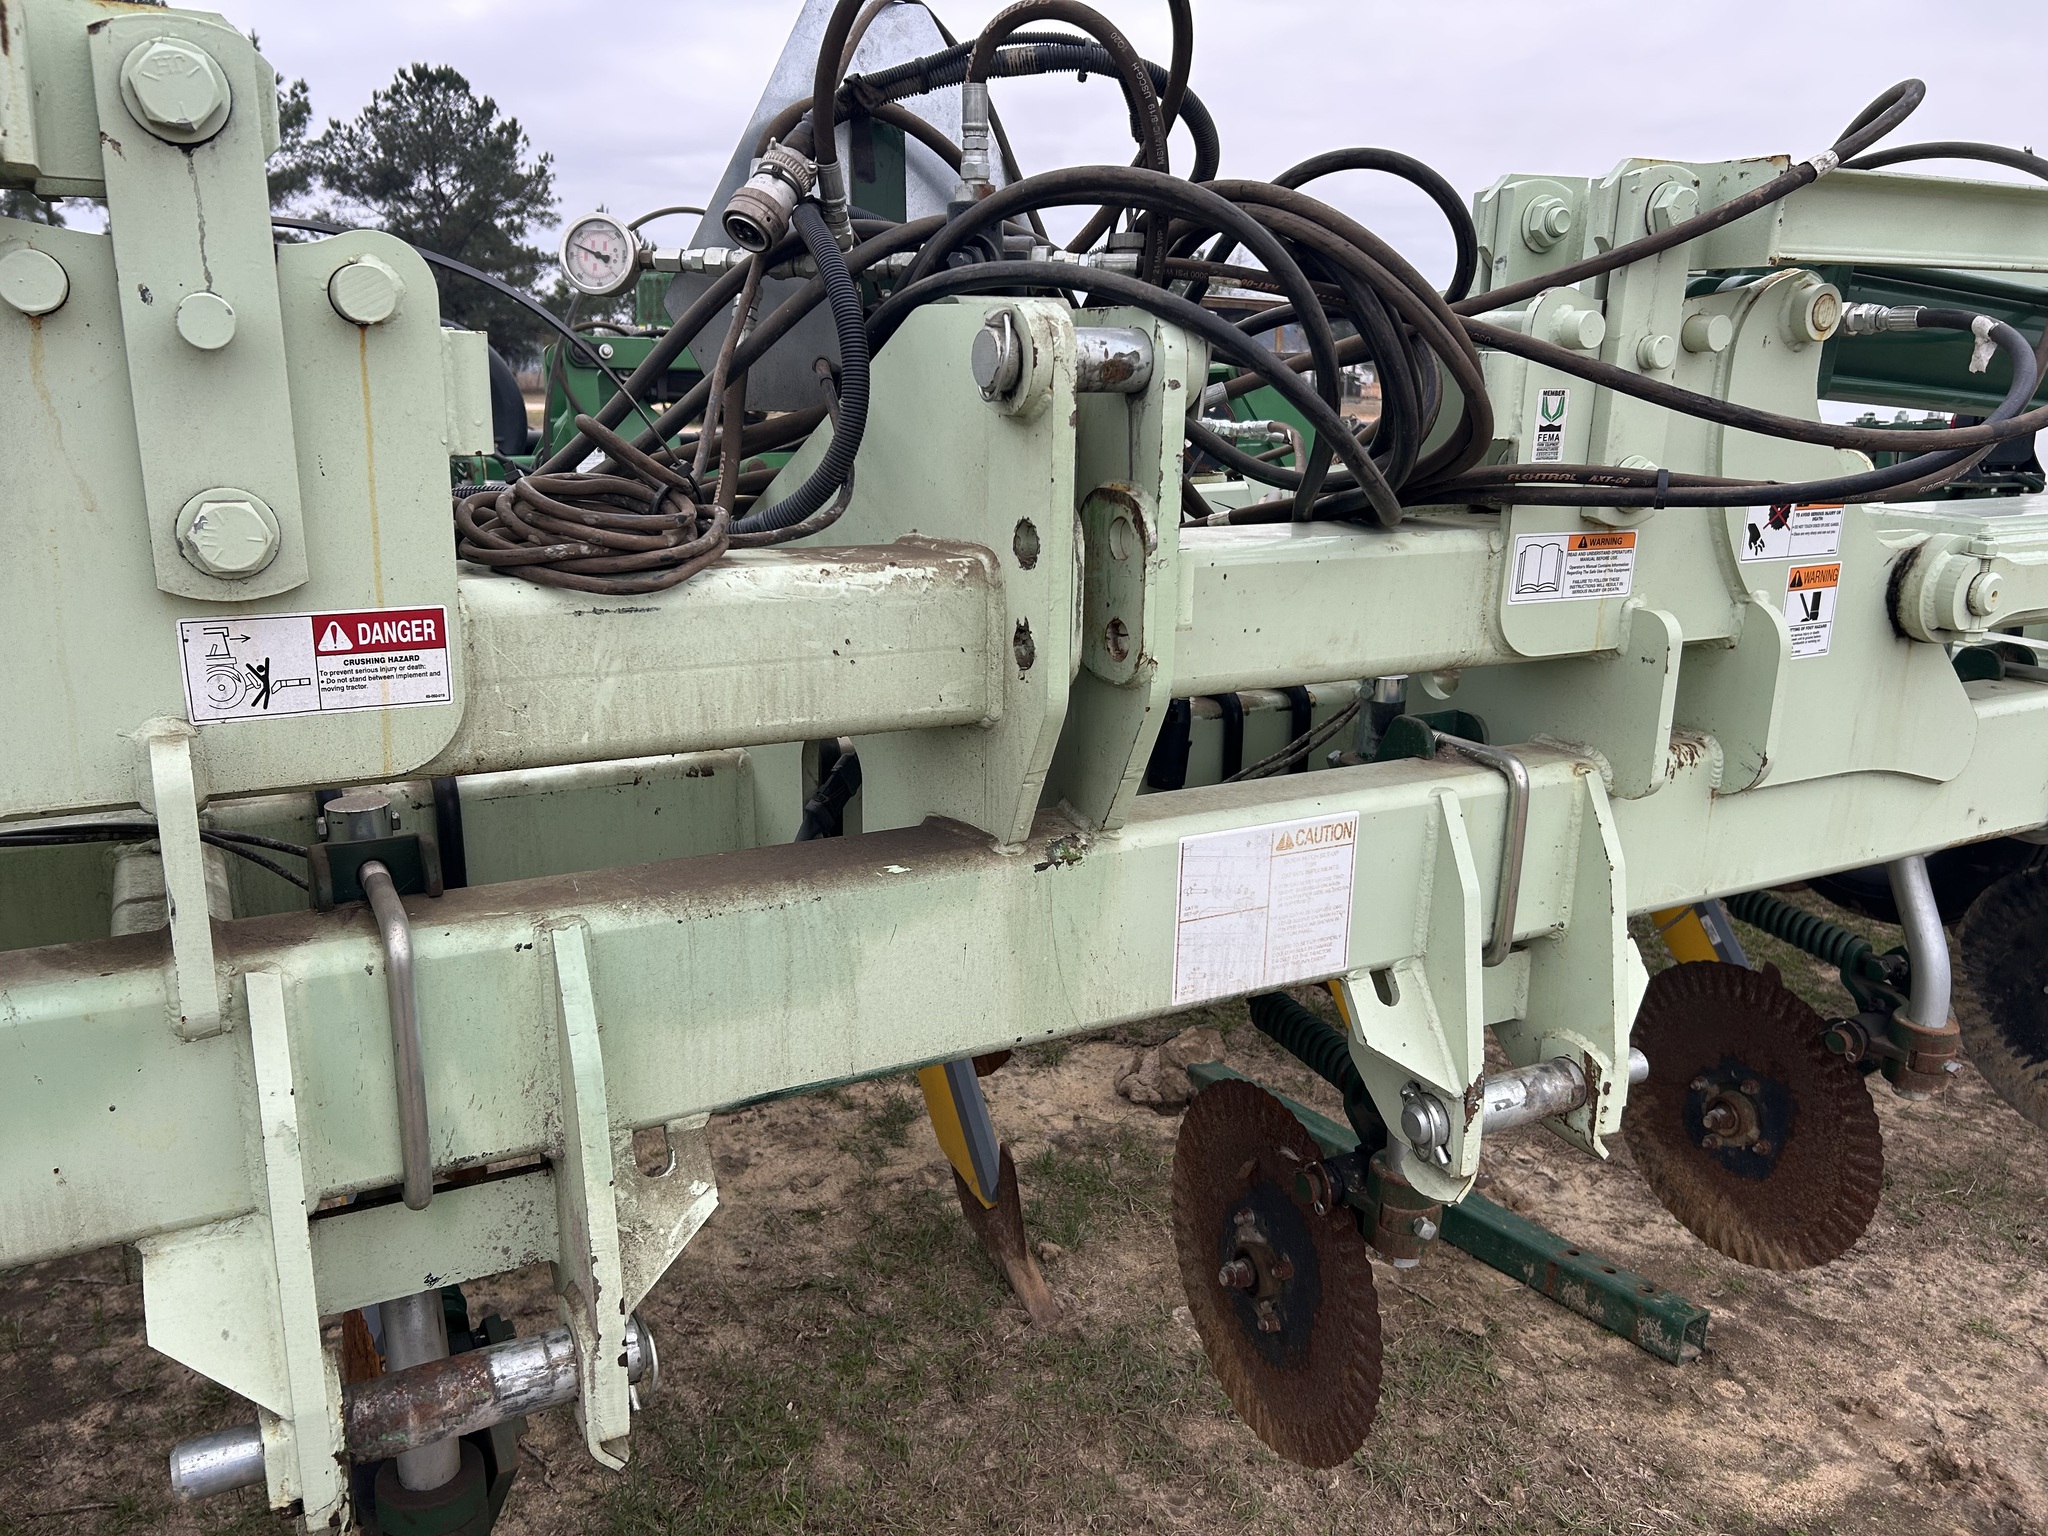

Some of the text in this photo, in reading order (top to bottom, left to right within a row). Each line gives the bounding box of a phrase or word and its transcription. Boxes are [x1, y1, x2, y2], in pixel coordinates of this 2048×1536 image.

[1131, 62, 1152, 99] USCG-H
[1148, 103, 1160, 136] IC-8/19
[1157, 230, 1163, 244] WP
[1175, 269, 1188, 278] PSI
[1537, 433, 1560, 442] FEMA
[1590, 537, 1622, 546] WARNING
[1804, 568, 1839, 584] WARNING
[357, 619, 436, 645] DANGER
[343, 655, 420, 666] CRUSHING HAZARD
[329, 669, 354, 677] prevent
[380, 665, 398, 673] injury
[1296, 821, 1352, 846] CAUTION
